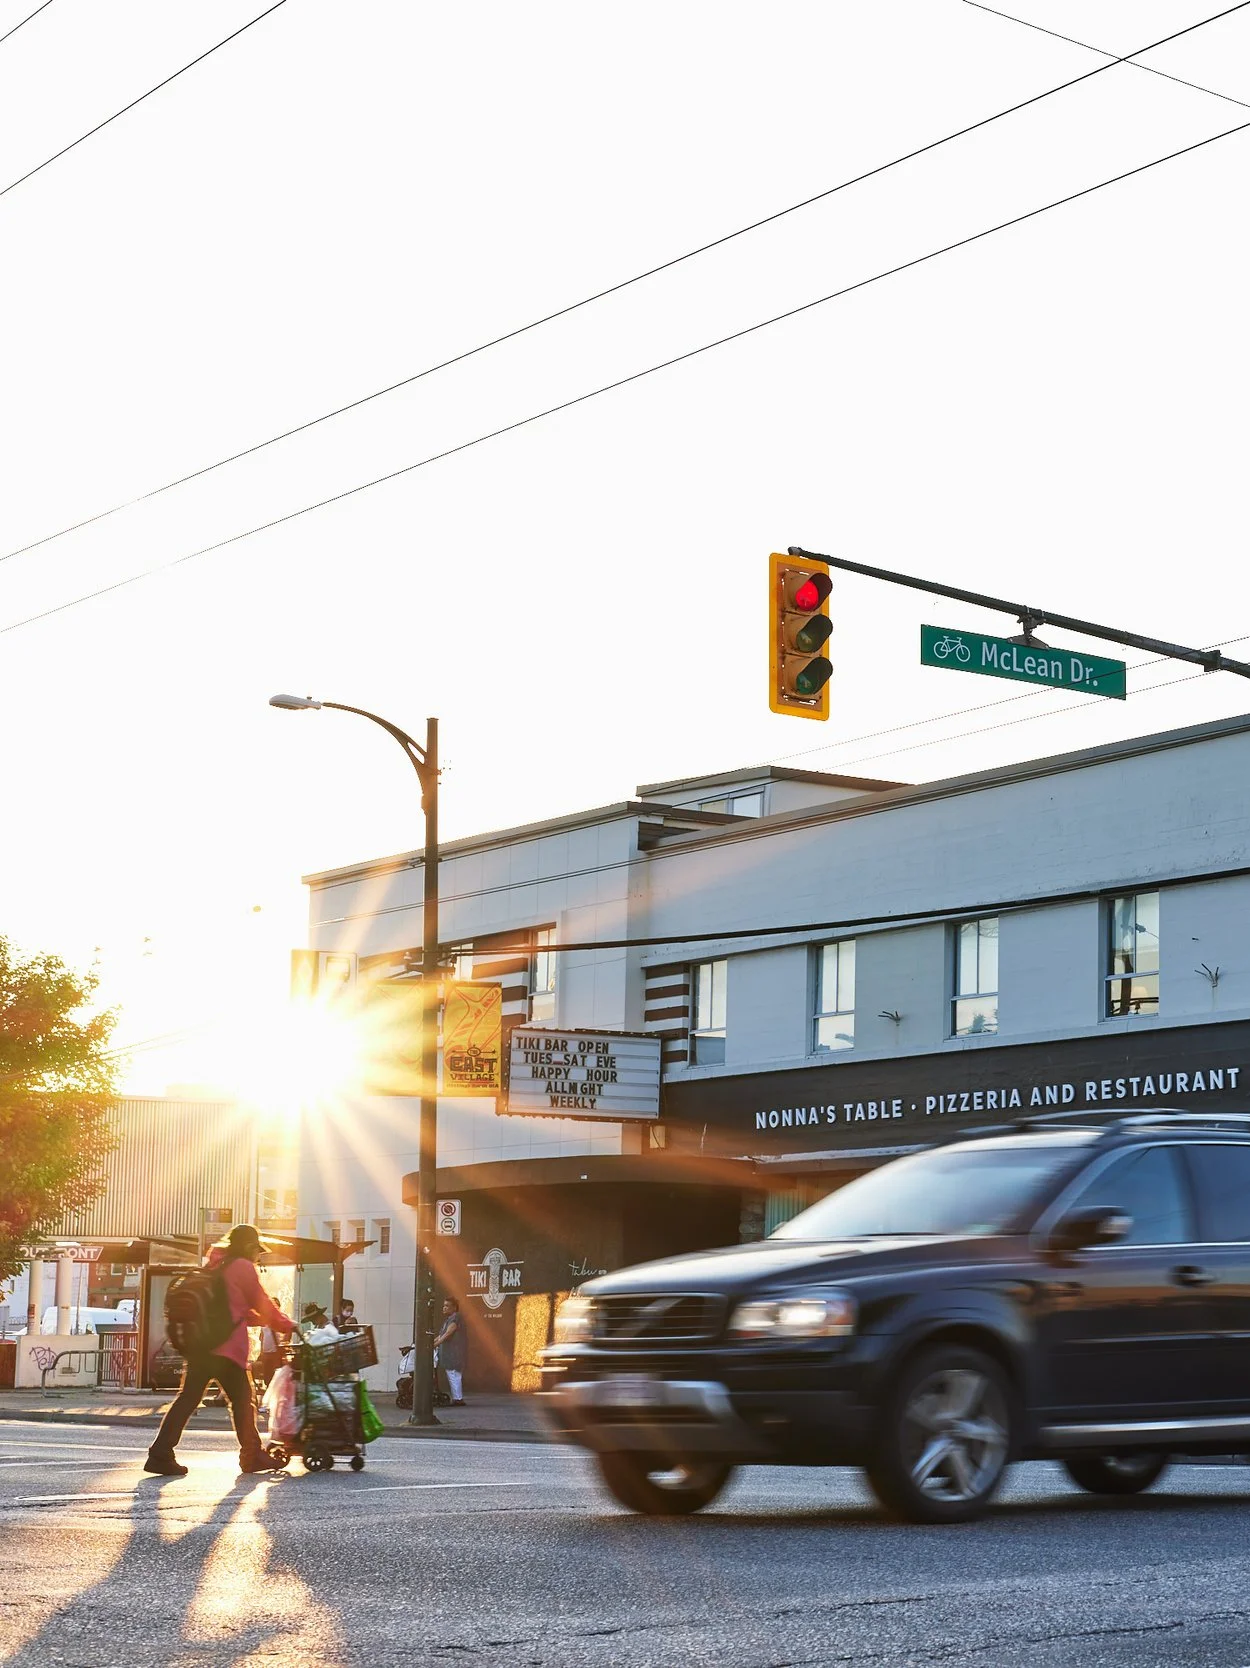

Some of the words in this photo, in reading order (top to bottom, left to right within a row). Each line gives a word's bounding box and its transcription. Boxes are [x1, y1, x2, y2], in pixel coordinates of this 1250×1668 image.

[981, 641, 1063, 680] McLean
[1070, 657, 1099, 687] Dr.
[516, 1037, 540, 1050] TIKI
[544, 1038, 568, 1052] BAR
[578, 1041, 609, 1055] OPEN
[450, 1056, 498, 1074] EAST
[596, 1056, 616, 1069] EVE
[450, 1073, 495, 1081] VILLAGE
[531, 1066, 571, 1080] HAPPY
[586, 1068, 618, 1083] HOUR
[550, 1095, 597, 1110] WEEKLY
[755, 1104, 837, 1130] NONNA'S
[843, 1099, 903, 1122] TABLE
[926, 1088, 1022, 1115] PIZZERIA
[1029, 1083, 1076, 1106] AND
[1085, 1067, 1240, 1102] RESTAURANT
[469, 1270, 487, 1288] TIKI
[502, 1267, 521, 1288] BAR
